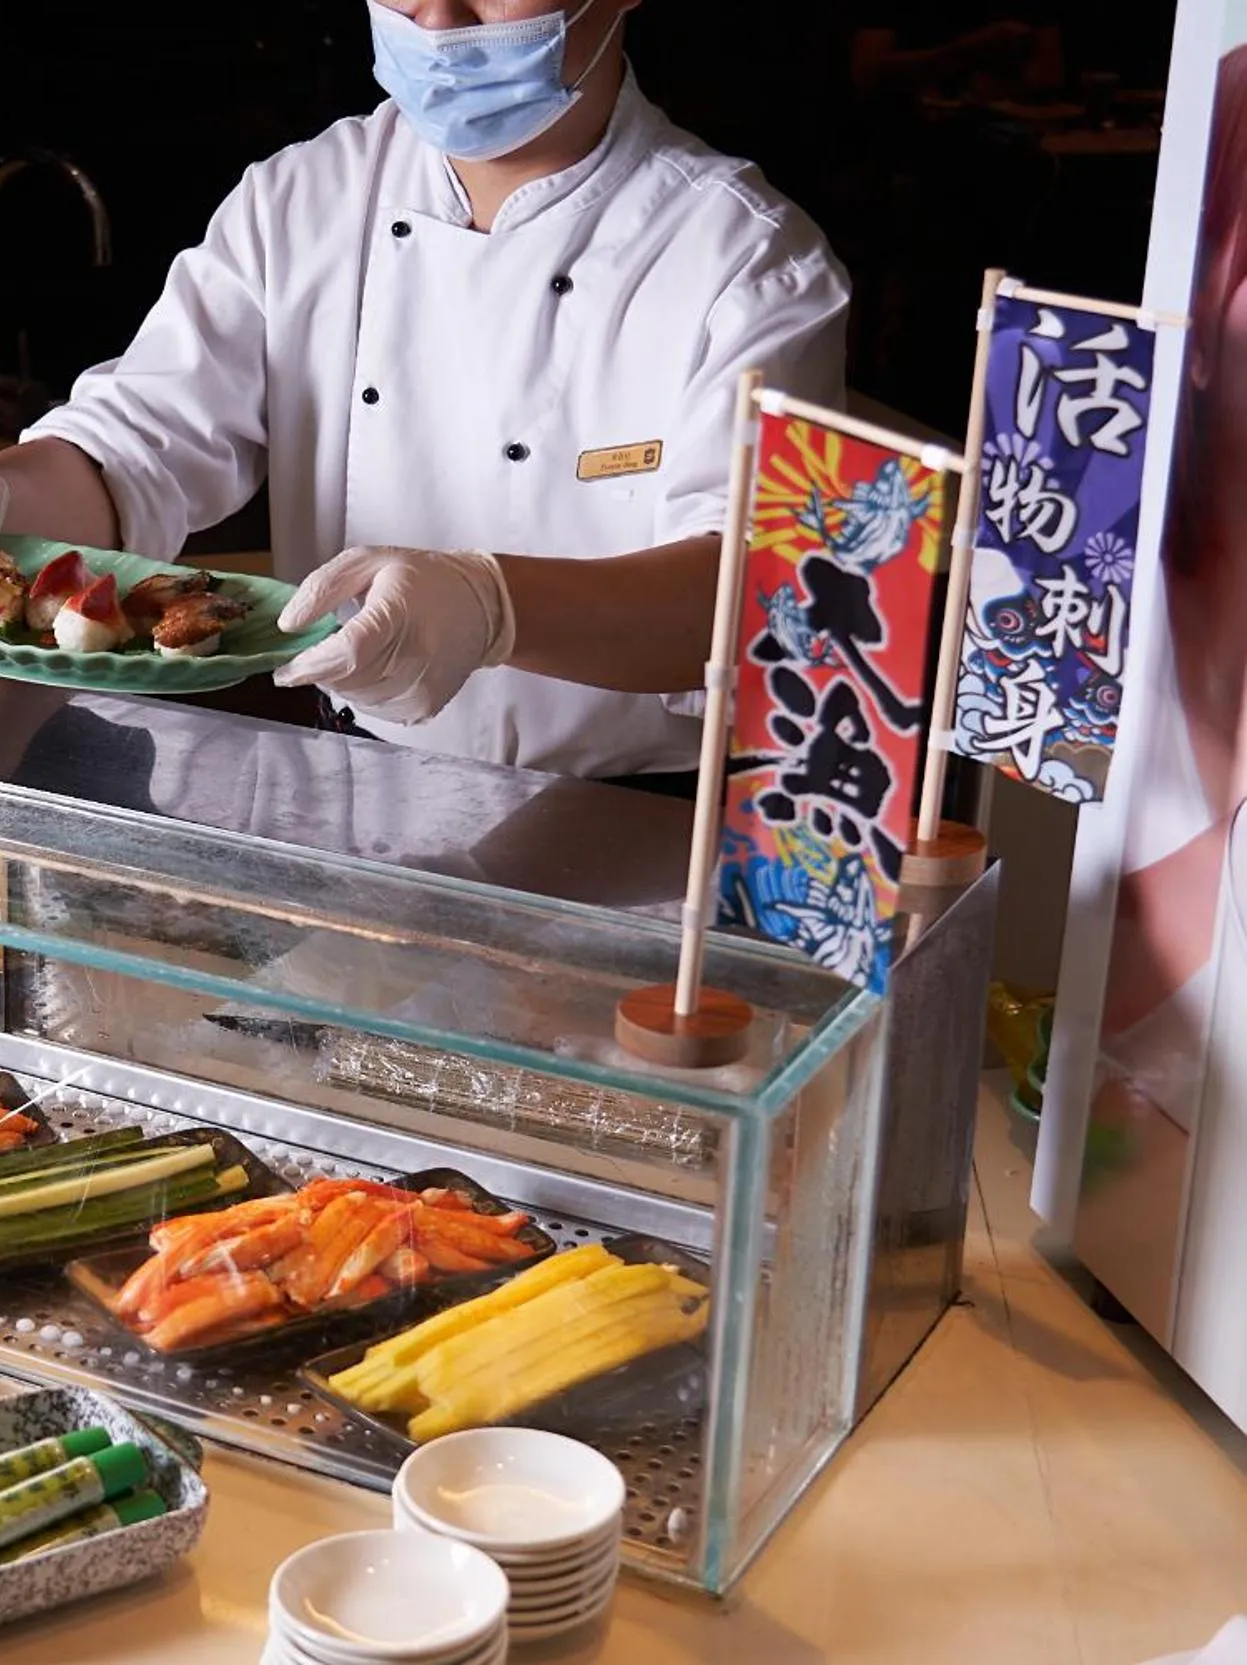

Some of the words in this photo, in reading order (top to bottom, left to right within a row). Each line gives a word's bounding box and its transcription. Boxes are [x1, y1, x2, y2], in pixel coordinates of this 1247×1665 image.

[726, 555, 921, 883] 大漁
[973, 308, 1147, 781] 活物刺身
